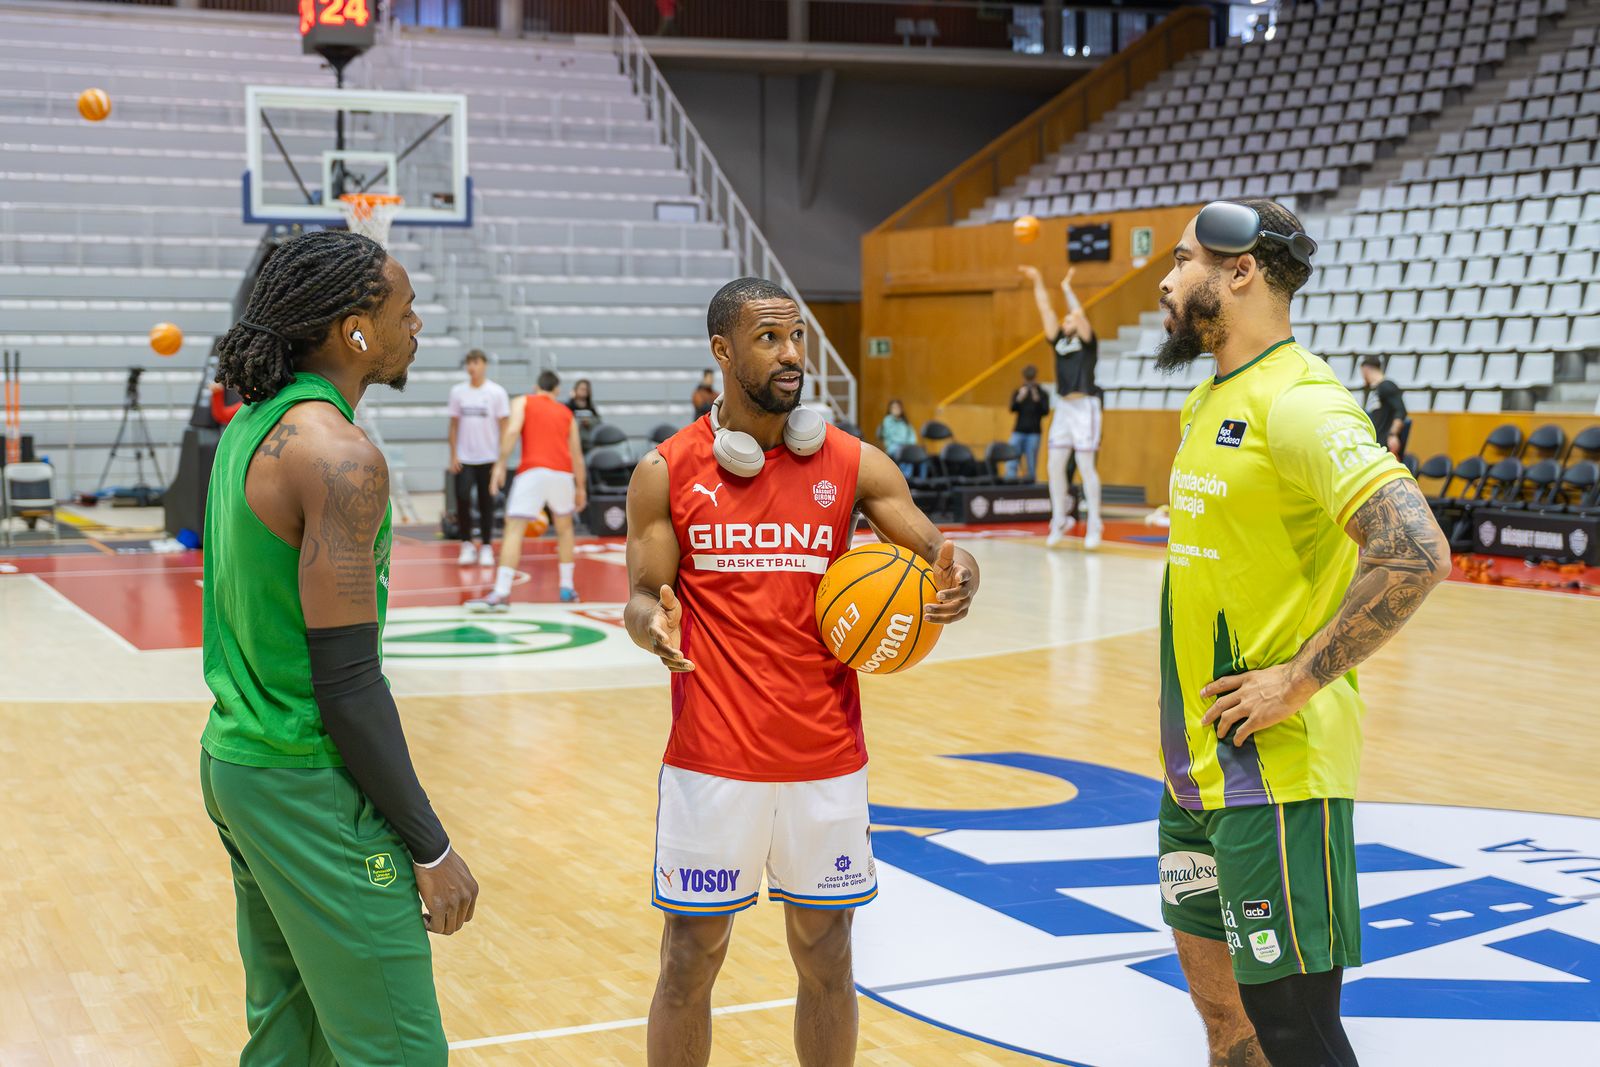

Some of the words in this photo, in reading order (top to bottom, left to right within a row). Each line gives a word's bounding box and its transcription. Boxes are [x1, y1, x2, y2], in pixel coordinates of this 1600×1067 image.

[319, 0, 369, 26] 24
[1218, 436, 1240, 445] endesa
[687, 523, 833, 551] GIRONA
[1203, 547, 1220, 560] SOL
[717, 558, 807, 569] BASKETBALL
[857, 613, 914, 673] Wilson
[679, 867, 741, 893] YOSOY
[1245, 908, 1264, 916] acb
